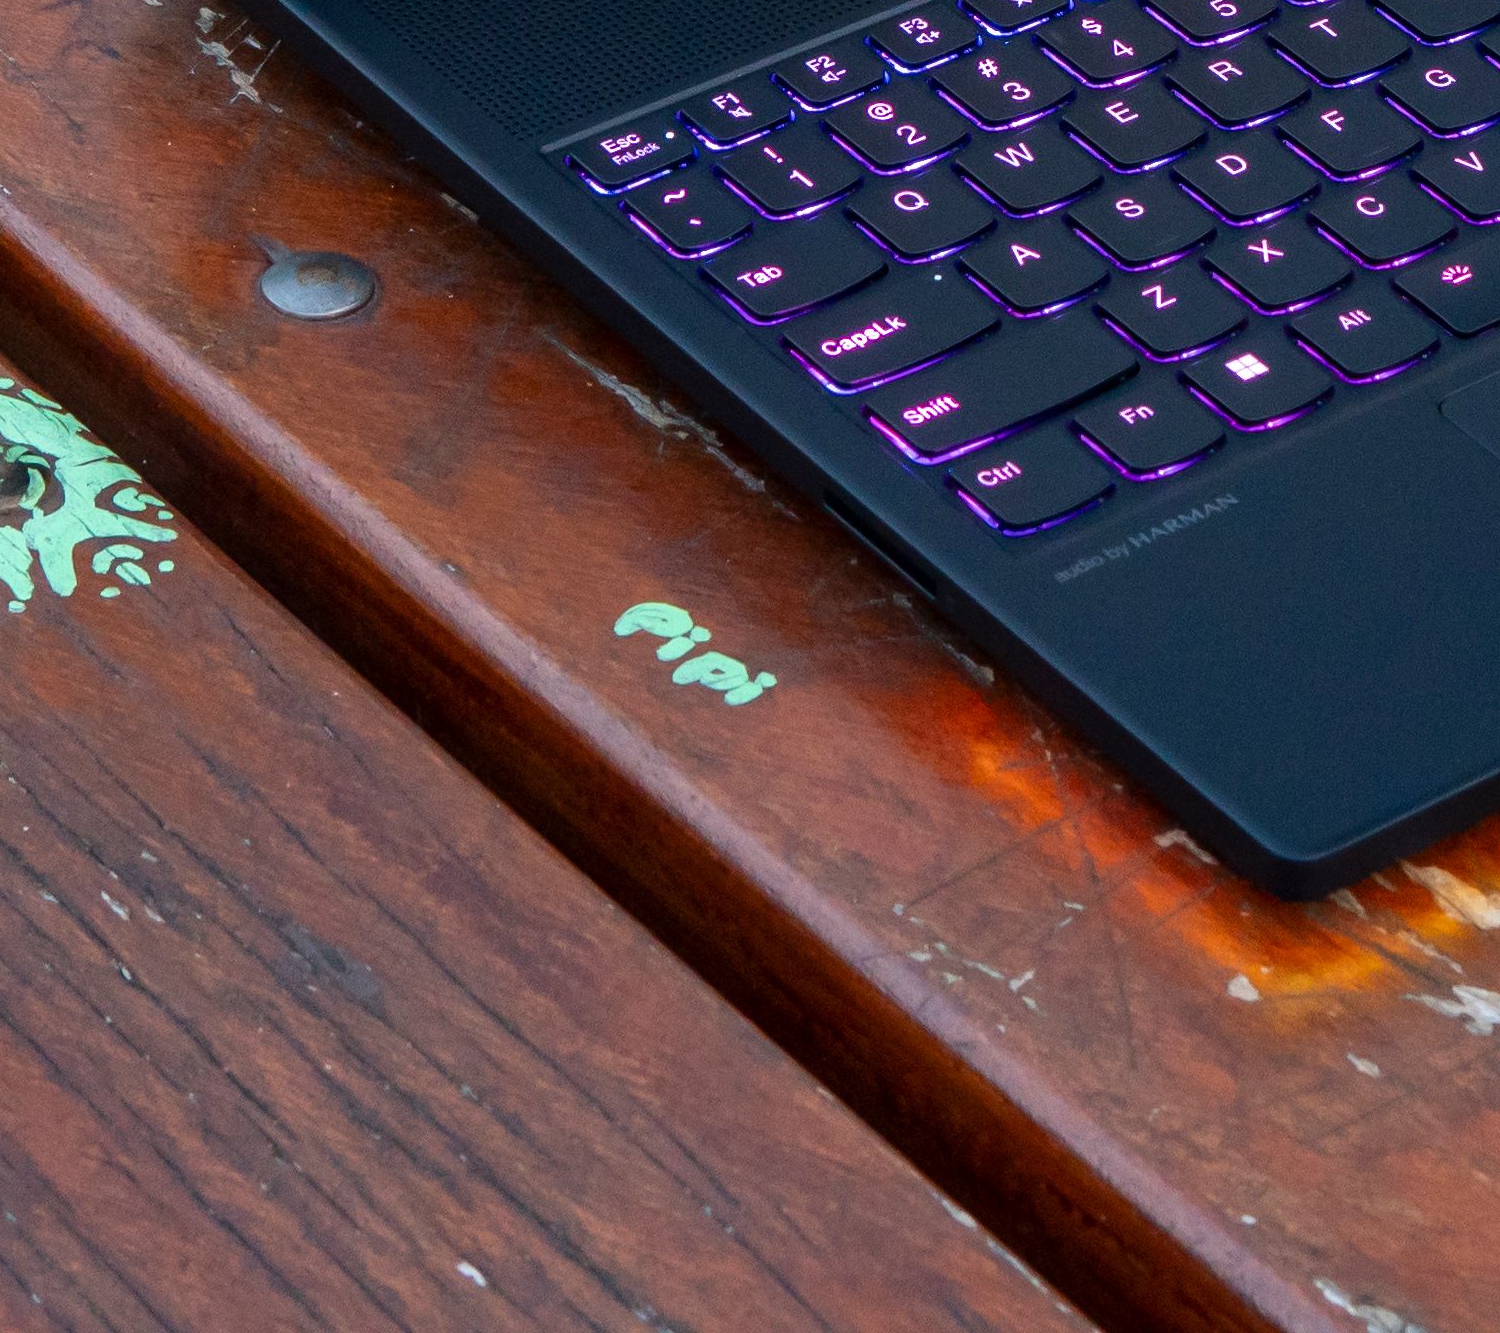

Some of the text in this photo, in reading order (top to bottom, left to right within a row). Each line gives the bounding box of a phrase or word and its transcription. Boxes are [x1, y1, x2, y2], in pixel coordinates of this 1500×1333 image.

[899, 17, 929, 36] F3
[805, 55, 836, 73] F2
[711, 92, 740, 109] F1
[600, 133, 640, 153] Esc
[612, 142, 661, 165] FnLock
[737, 266, 783, 287] Tab
[1339, 308, 1372, 332] Alt
[820, 316, 907, 357] CapsLk
[902, 394, 960, 425] Shift
[1119, 404, 1155, 425] Fn
[977, 461, 1022, 487] Ctrl
[1103, 544, 1130, 560] by
[1128, 492, 1240, 549] HARMAN
